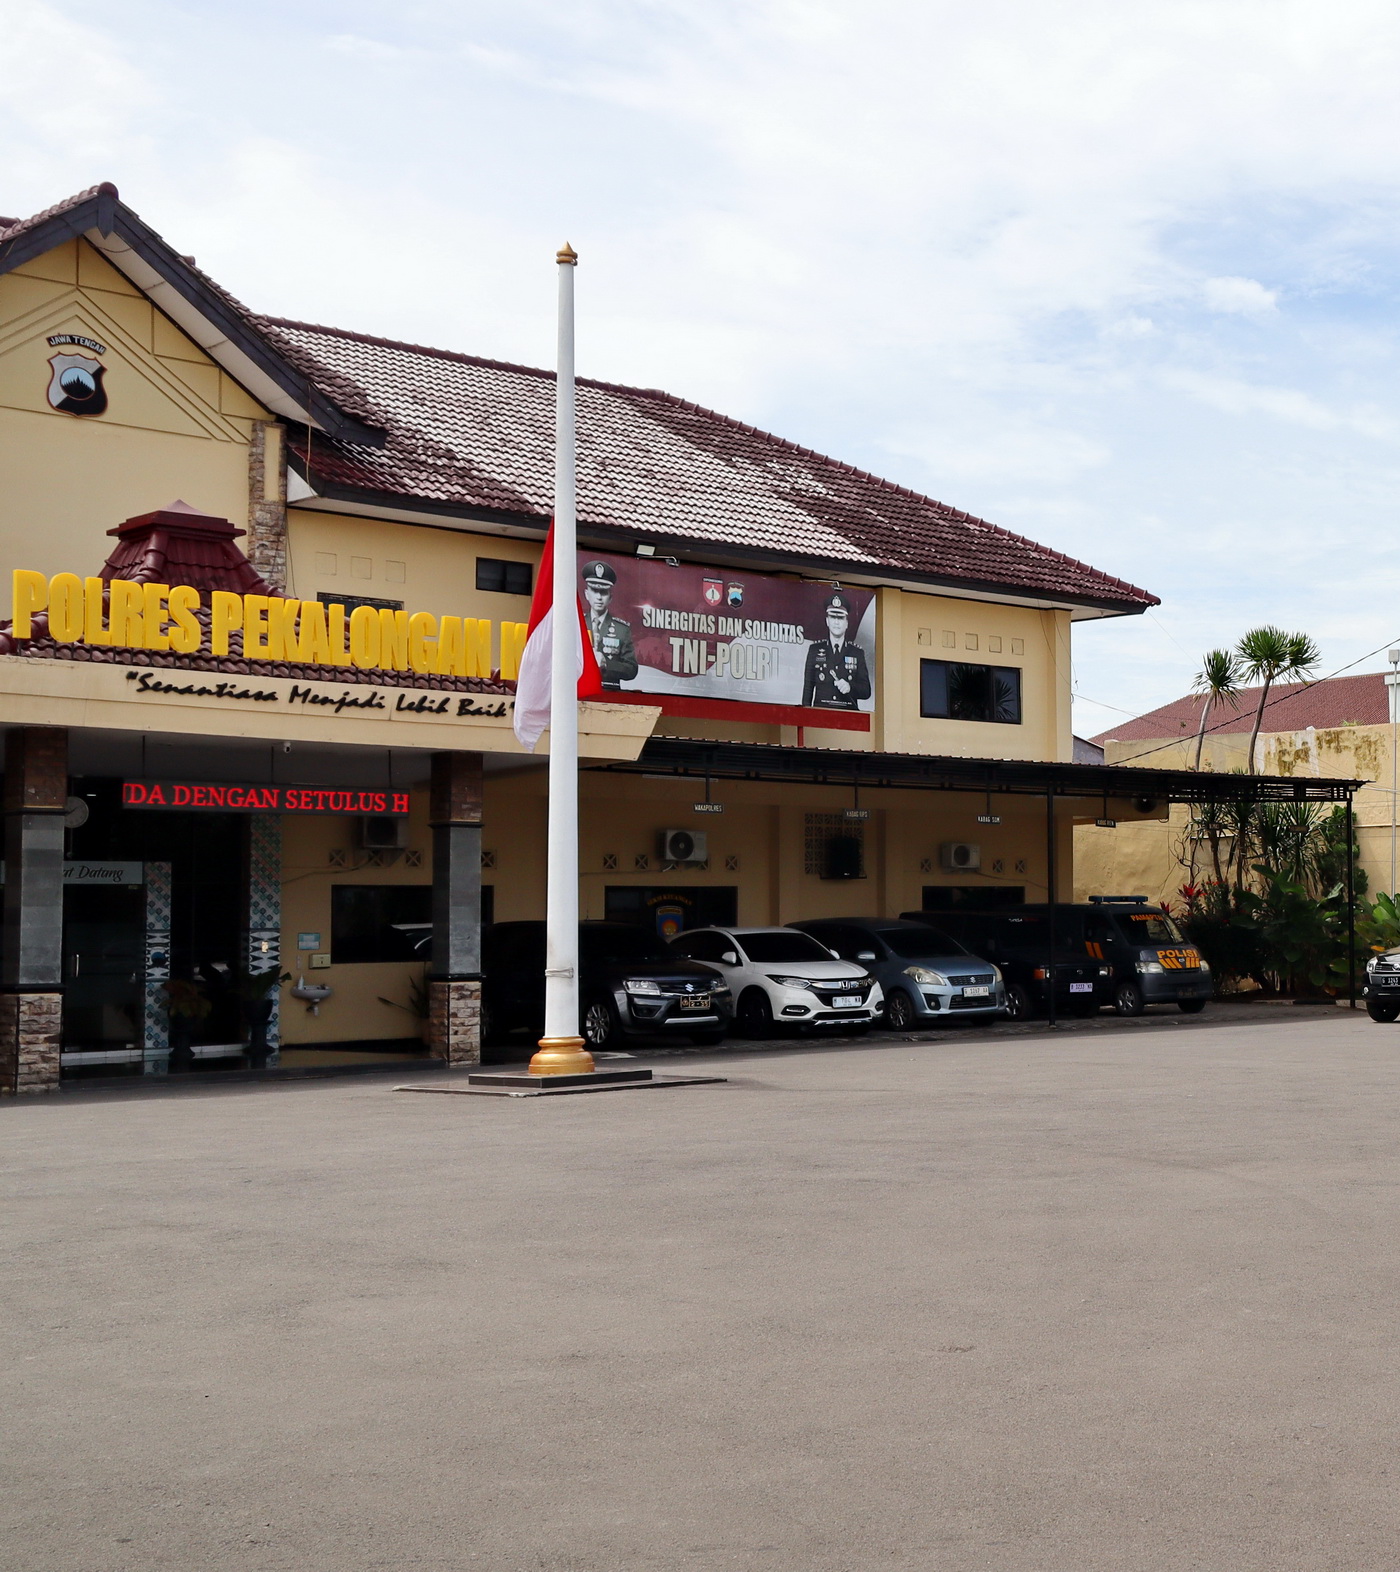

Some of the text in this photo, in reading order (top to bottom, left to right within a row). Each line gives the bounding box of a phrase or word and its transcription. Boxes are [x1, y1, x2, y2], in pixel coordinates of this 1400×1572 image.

[49, 335, 105, 355] JAWA TENGAH
[12, 569, 201, 653] POLRES
[211, 590, 491, 679] PEKALONGAN
[642, 607, 805, 645] SINERGITAS DAN SOLIDITAS
[669, 636, 780, 681] TNI-POLRI
[288, 684, 385, 713] Menjadi
[395, 693, 448, 713] Lebih
[172, 785, 280, 809] DENGAN
[284, 790, 386, 812] SETULUS
[76, 865, 124, 883] Datang
[1156, 949, 1199, 959] POLISI
